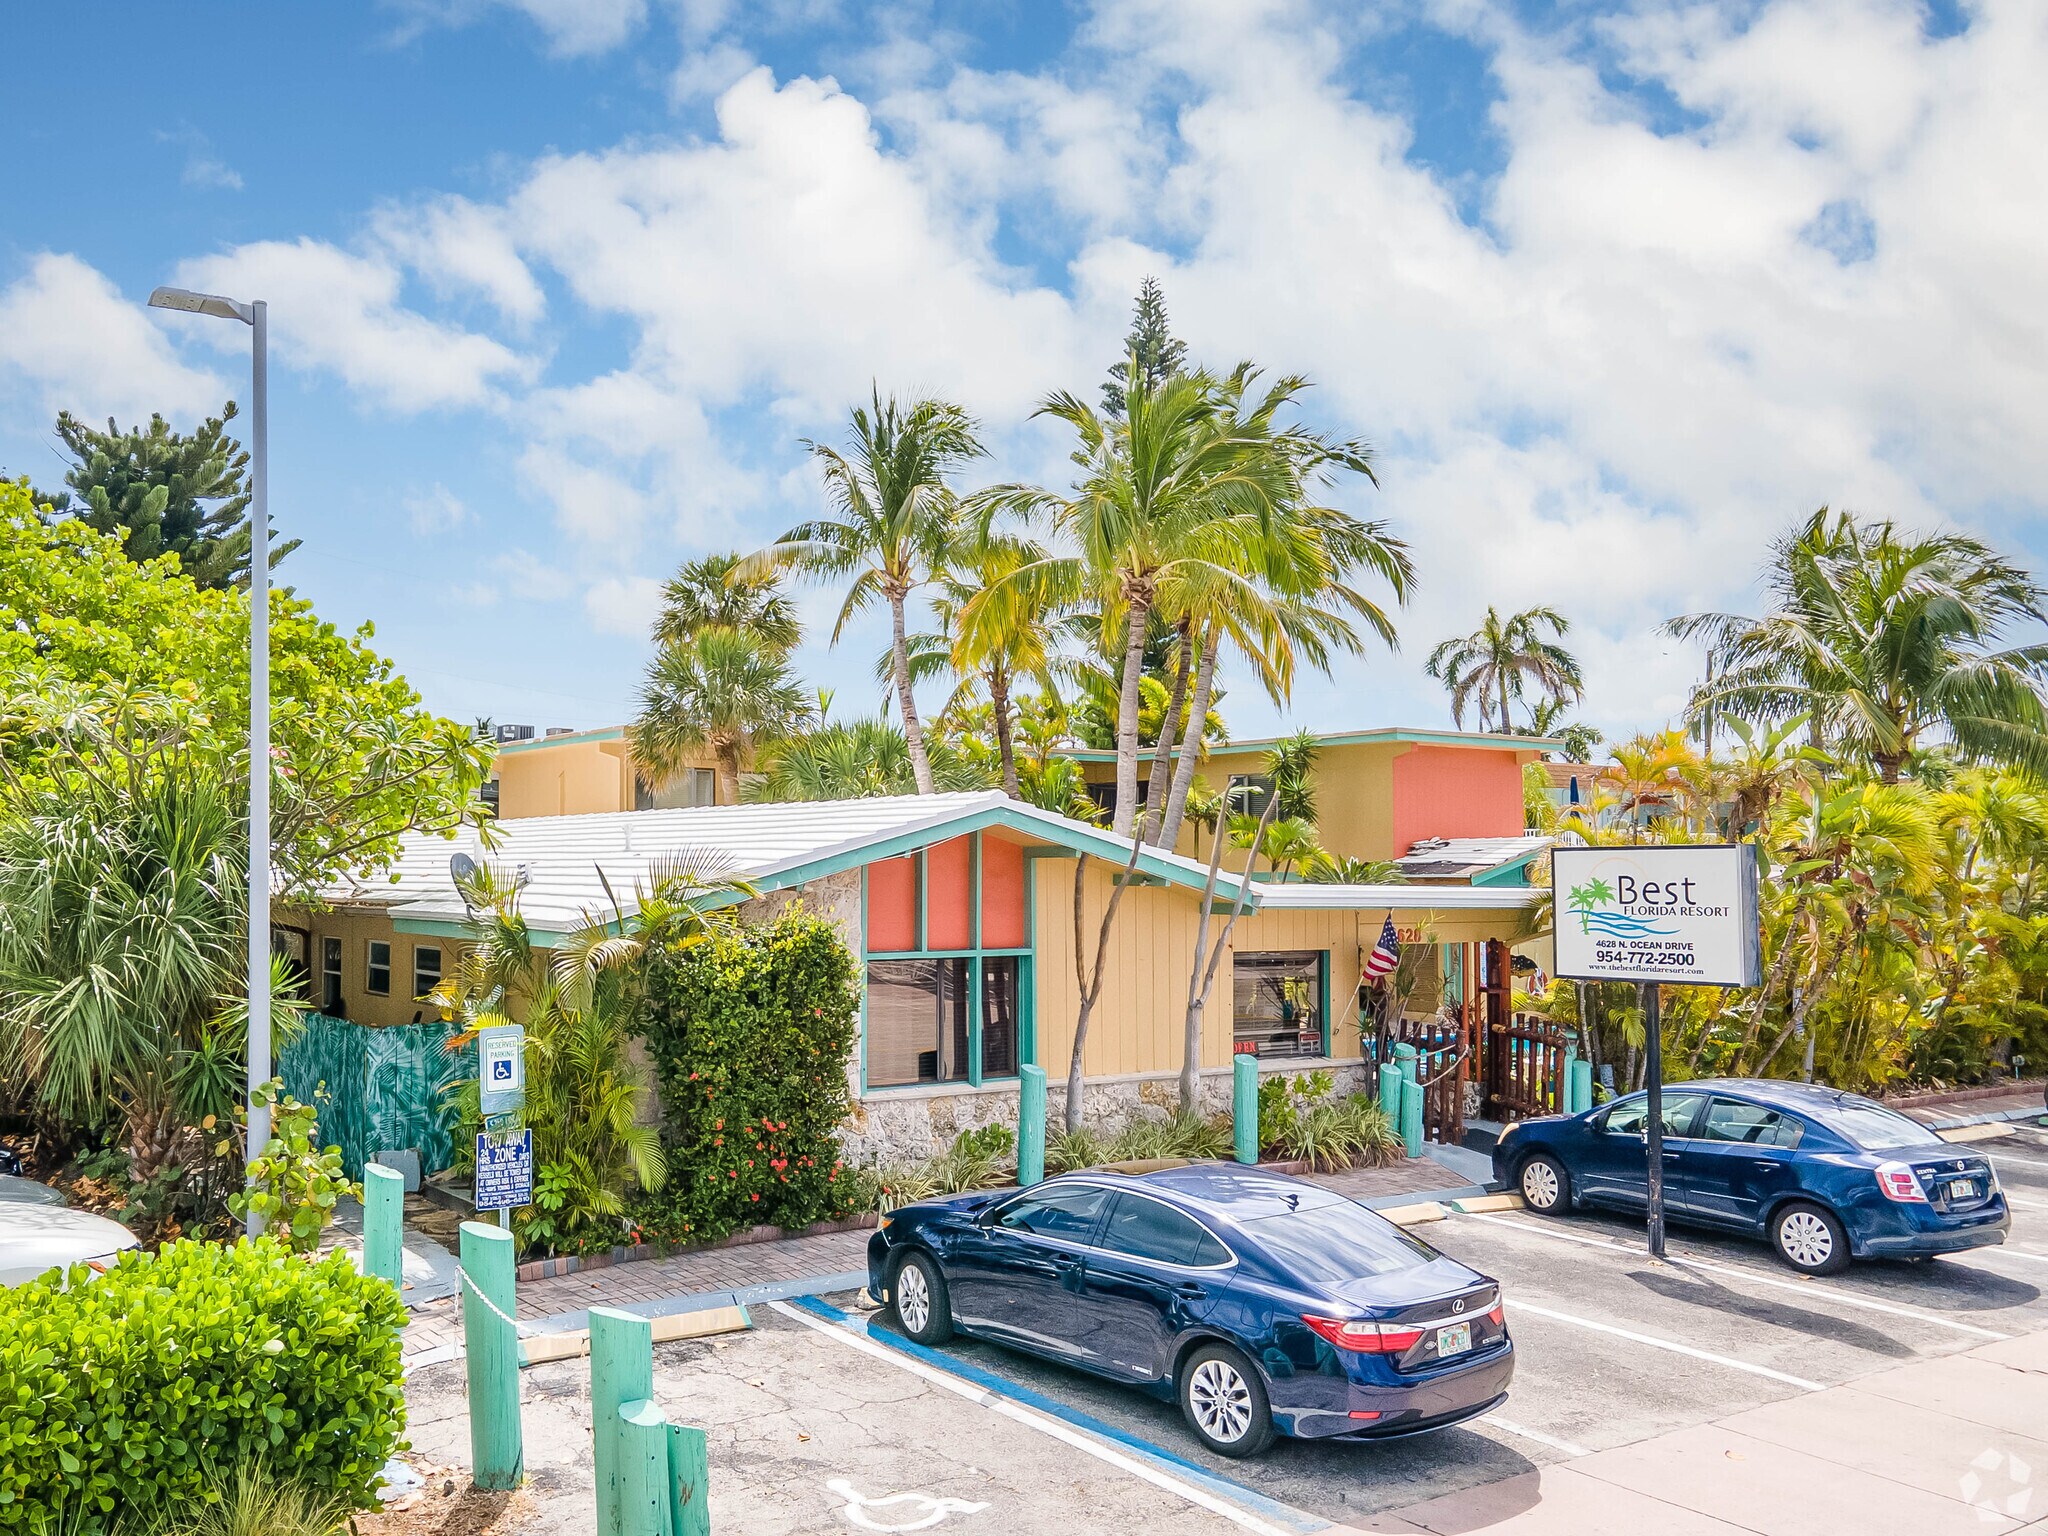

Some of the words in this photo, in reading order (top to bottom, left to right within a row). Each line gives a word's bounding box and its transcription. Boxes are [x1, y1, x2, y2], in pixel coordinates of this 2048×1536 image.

[1617, 875, 1697, 905] Best
[1624, 905, 1676, 916] FLORIDA
[1680, 906, 1730, 917] RESORT
[1596, 939, 1617, 949] 4628
[1619, 940, 1628, 949] N.
[1630, 941, 1662, 950] OCEAN
[1665, 942, 1694, 951] DRIVE
[1596, 950, 1695, 966] 954-772-2500
[1588, 963, 1704, 975] www.thebestfloridaresort.com
[487, 1040, 516, 1050] RESERVED
[490, 1050, 515, 1059] PARKING
[505, 1131, 525, 1147] AWAY
[480, 1149, 489, 1157] 24
[494, 1147, 517, 1163] ZONE
